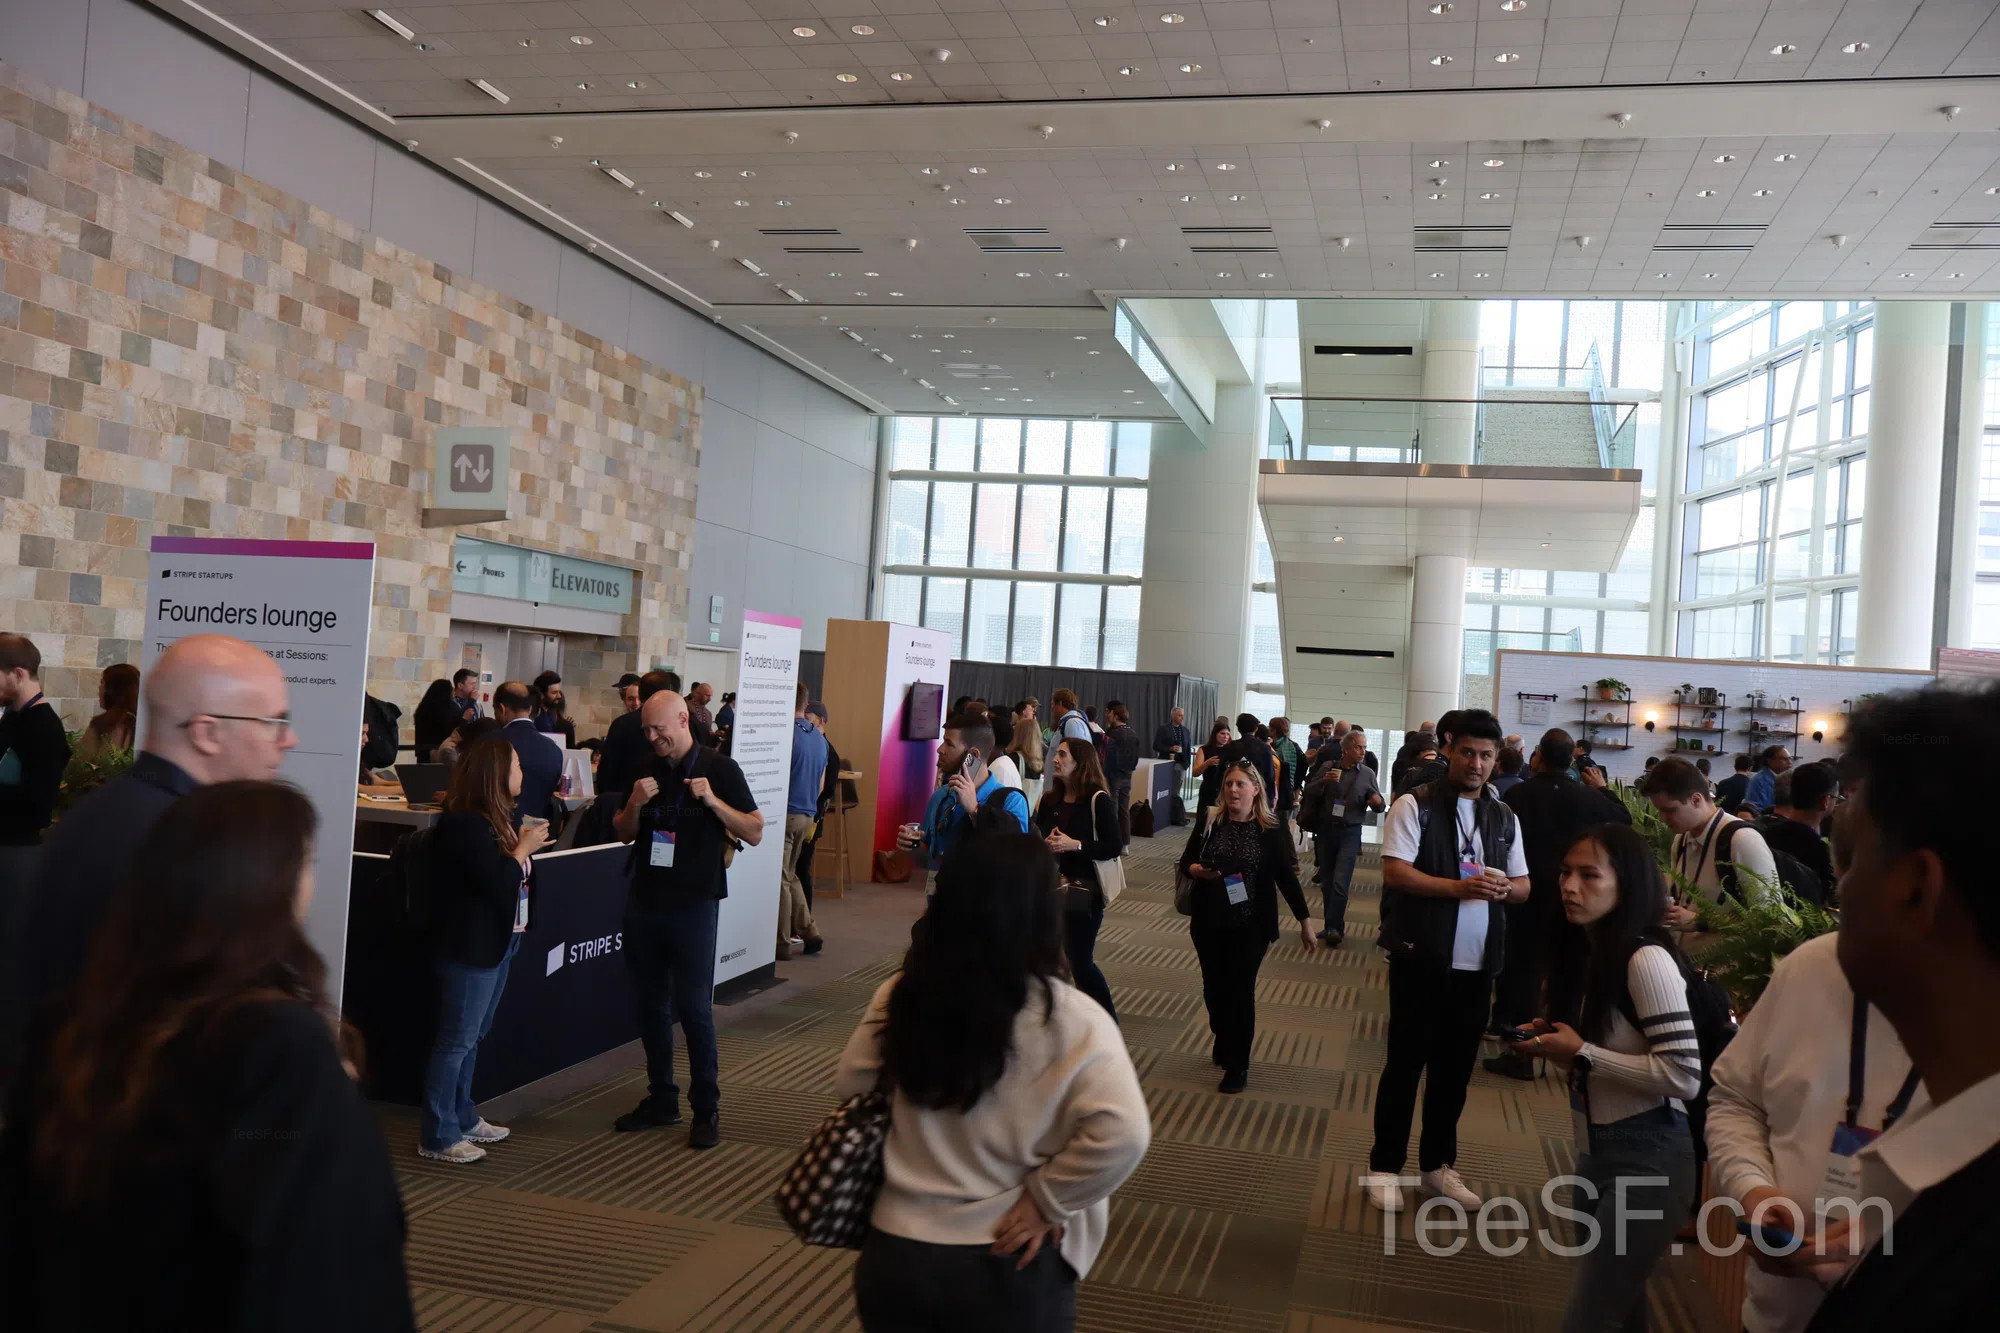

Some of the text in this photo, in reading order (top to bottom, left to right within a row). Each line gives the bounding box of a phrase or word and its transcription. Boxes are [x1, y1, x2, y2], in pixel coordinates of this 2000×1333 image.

[173, 571, 233, 580] STRIPE STARTUPS
[552, 567, 620, 598] ELEVATORS
[158, 598, 337, 633] Founders lounge
[275, 648, 284, 659] at
[286, 648, 329, 661] Sessions:
[744, 651, 792, 674] Founders lounge
[569, 935, 613, 964] STRIPE
